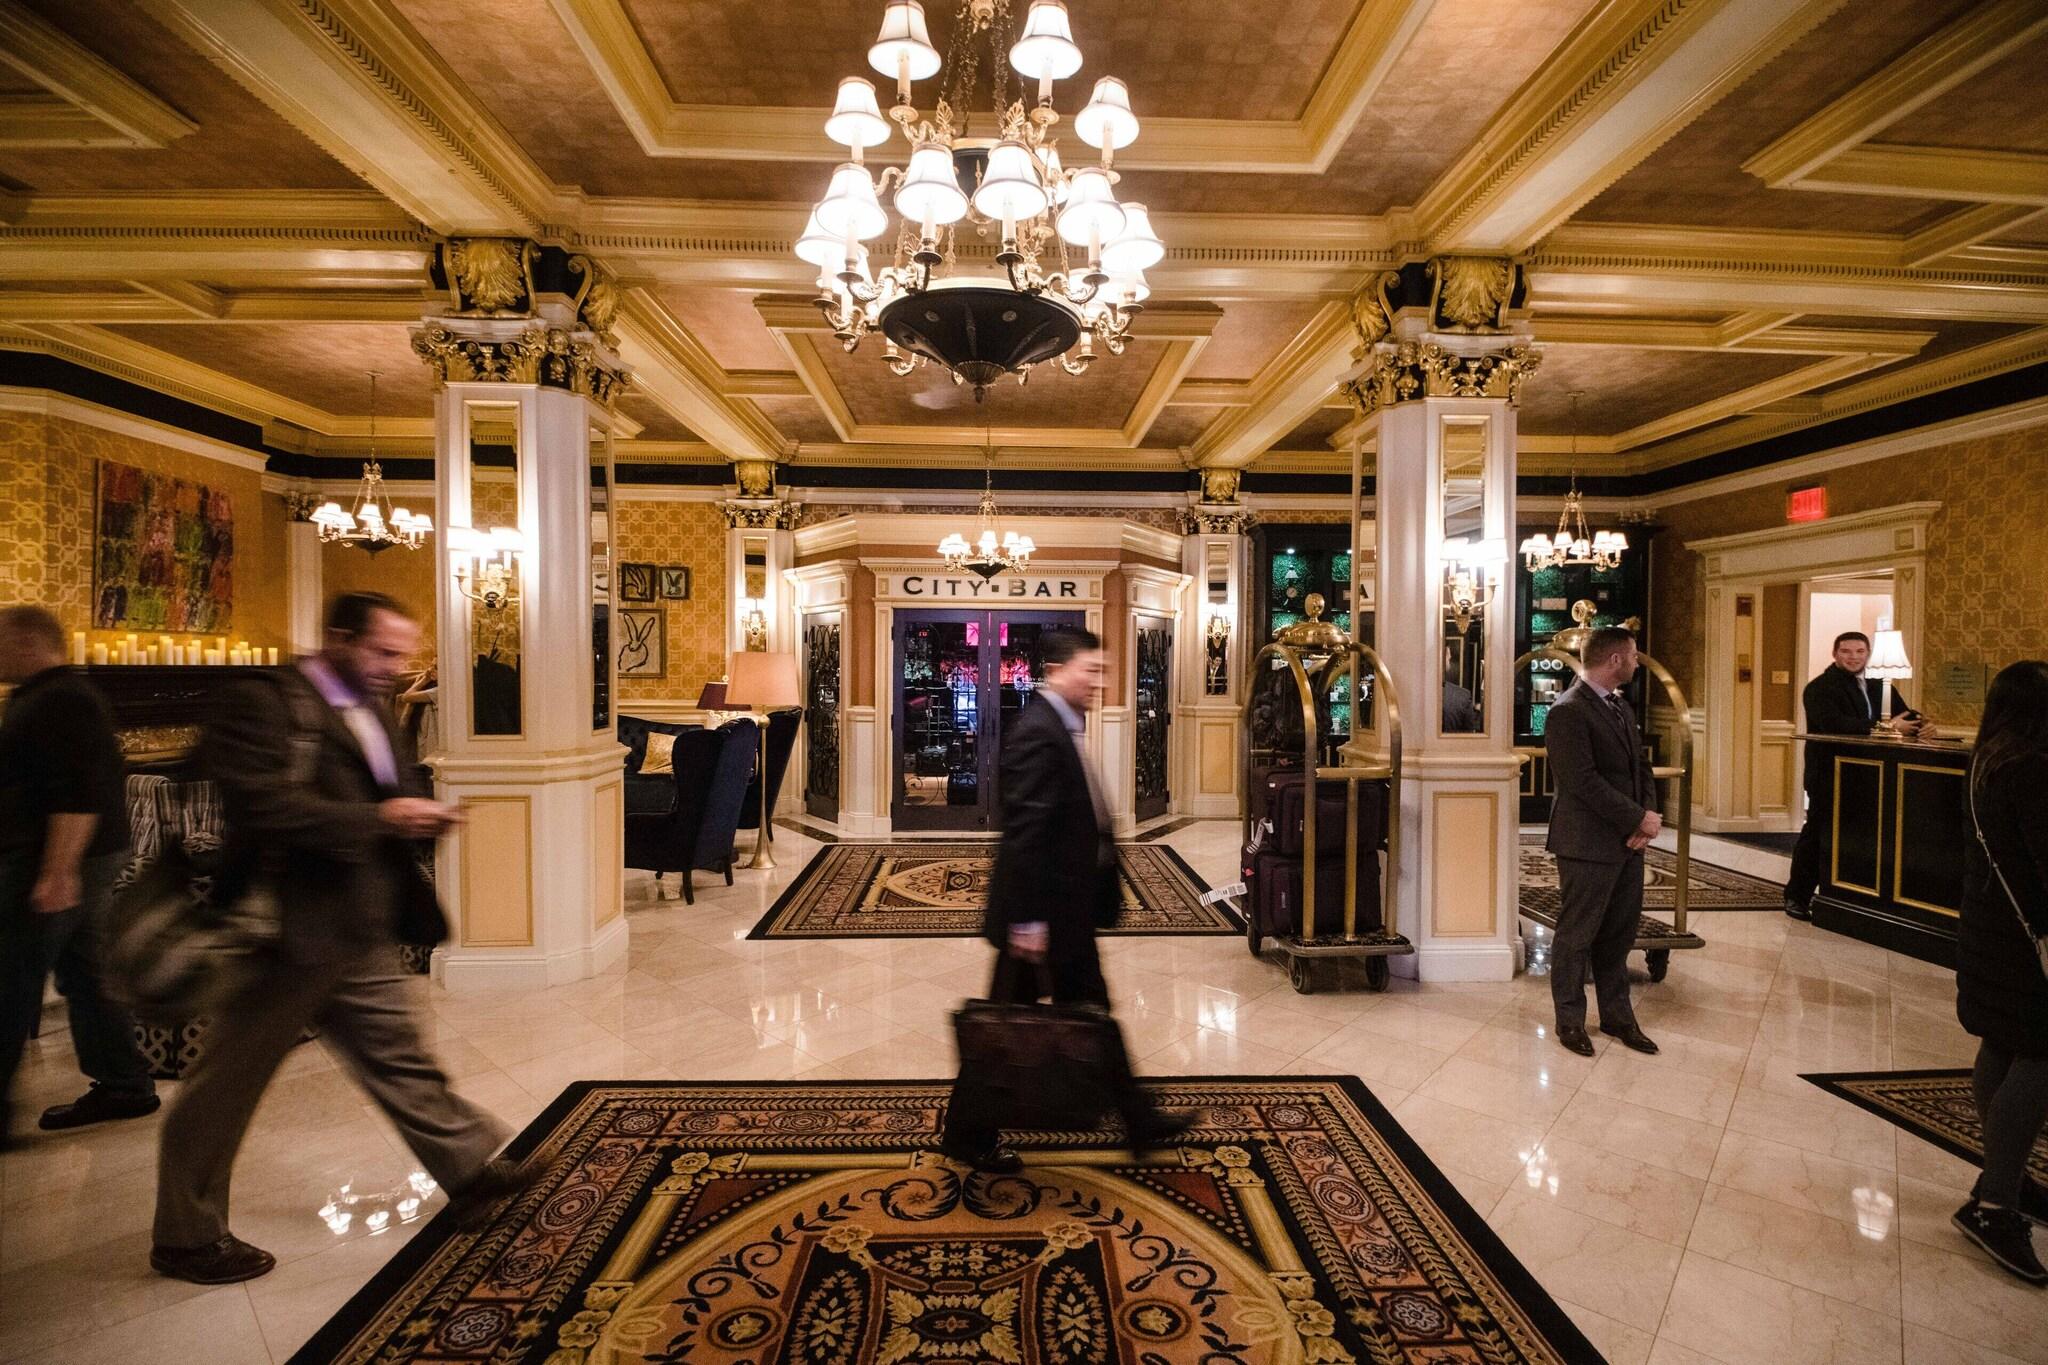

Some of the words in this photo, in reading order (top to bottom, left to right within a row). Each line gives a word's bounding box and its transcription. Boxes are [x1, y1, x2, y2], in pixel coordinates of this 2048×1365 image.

[1791, 490, 1821, 513] EXIT
[903, 576, 985, 596] CITY
[1008, 579, 1076, 597] BAR
